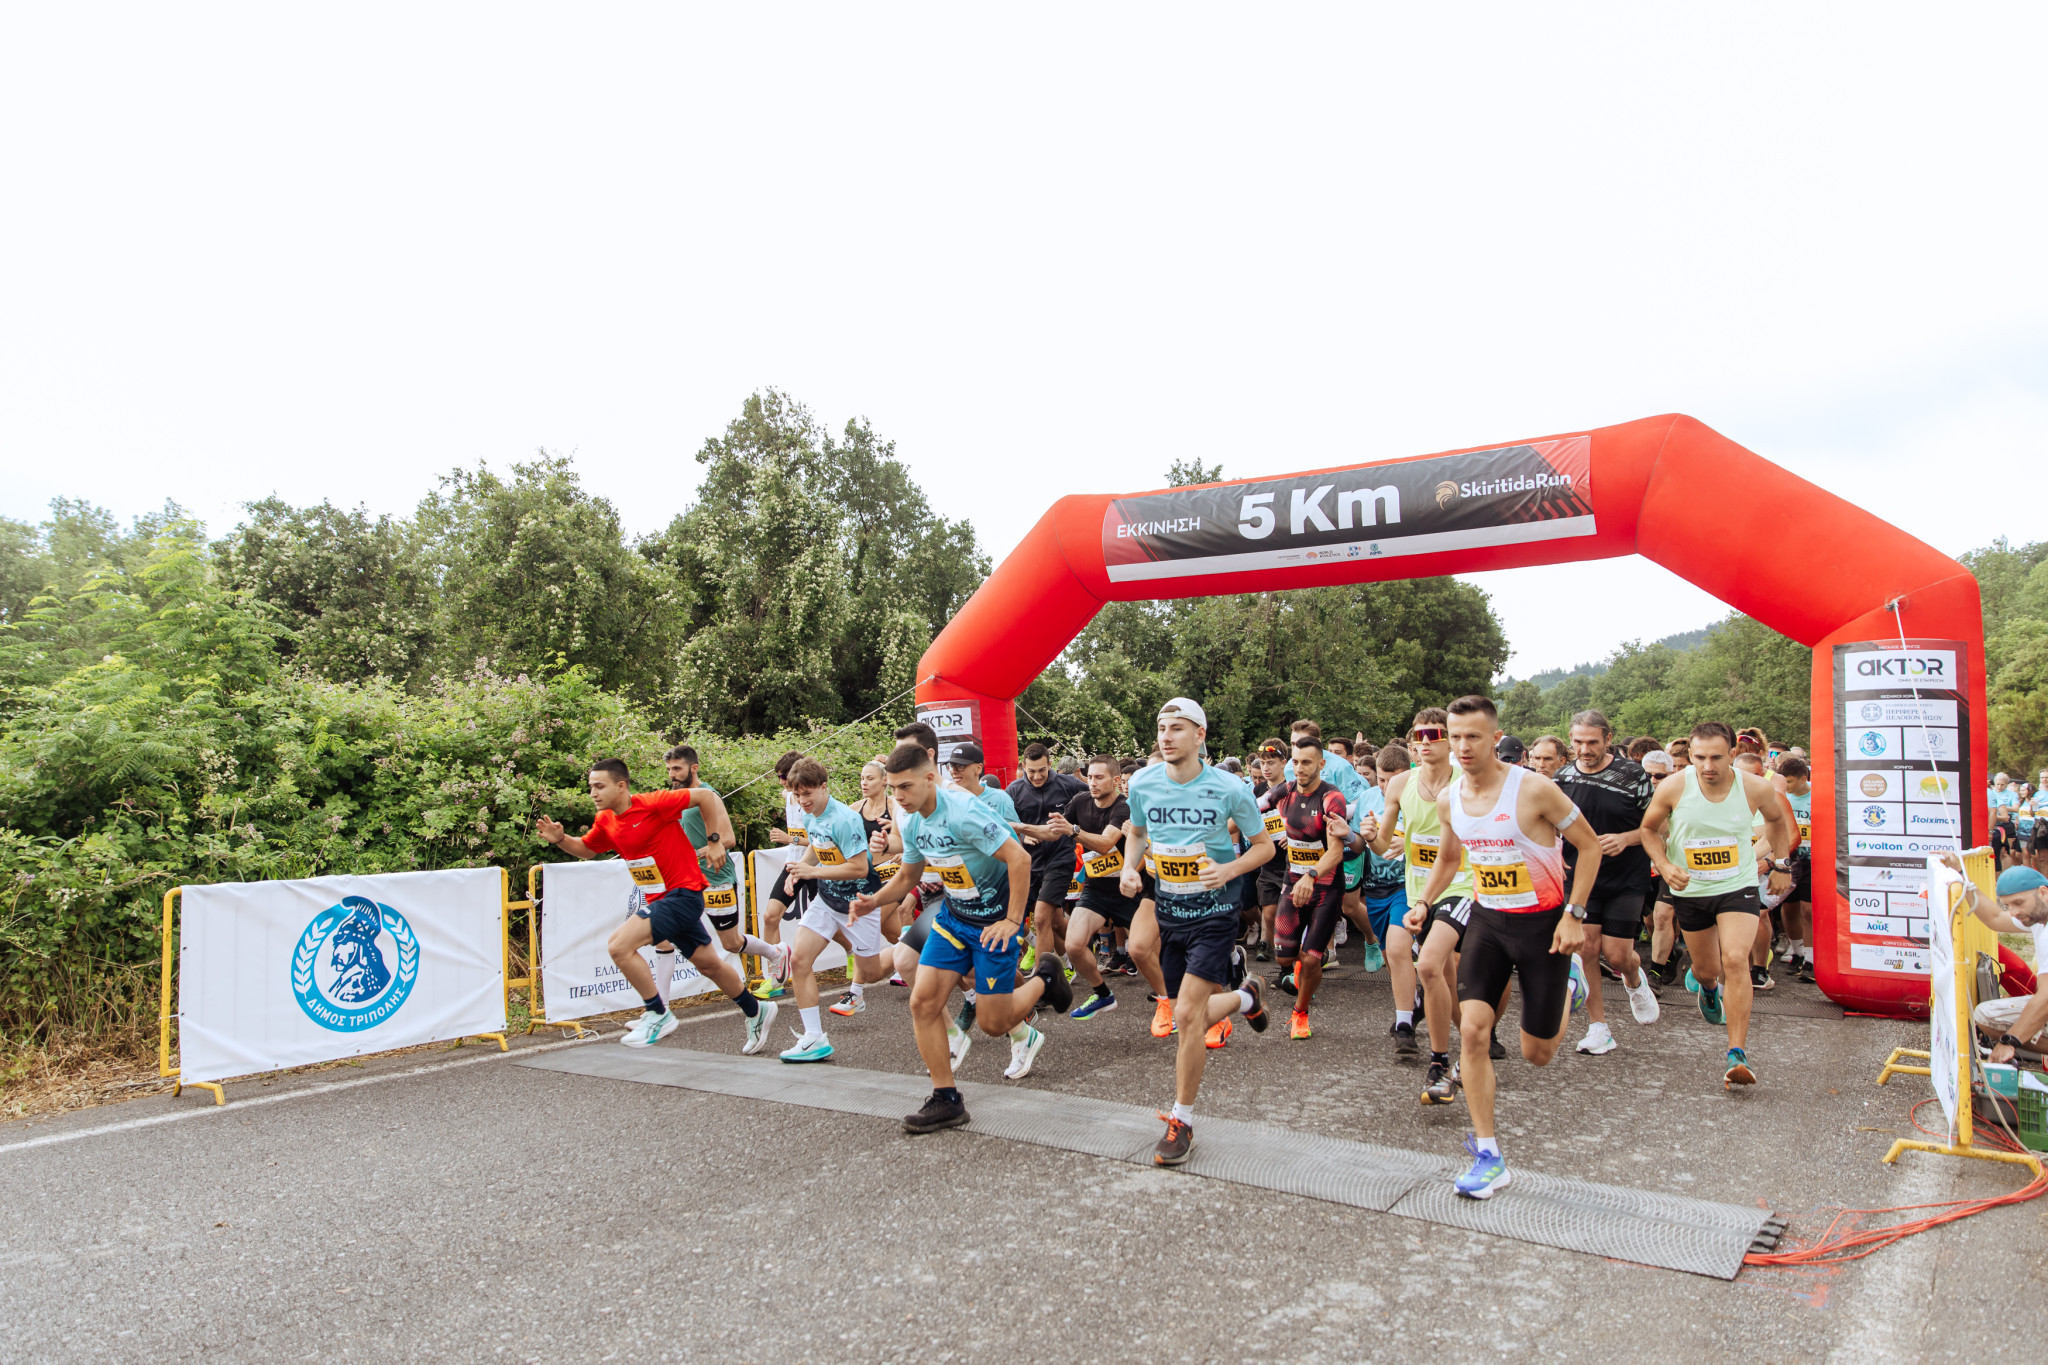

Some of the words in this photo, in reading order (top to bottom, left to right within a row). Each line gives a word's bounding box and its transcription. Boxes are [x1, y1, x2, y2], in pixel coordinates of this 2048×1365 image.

[1460, 473, 1572, 499] SkiritidaRun
[1237, 493, 1277, 540] 5
[1290, 483, 1402, 534] Km
[1117, 516, 1201, 539] ΕΚΚΙΝΗΣΗ
[1265, 818, 1283, 831] 5672
[1869, 842, 1903, 851] volton
[1419, 848, 1437, 863] 55
[1693, 850, 1731, 866] 5309
[1092, 855, 1119, 874] 5543
[1161, 861, 1199, 876] 5673
[633, 870, 656, 881] 5146
[708, 893, 731, 905] 5415
[306, 997, 345, 1027] ΔΗΜΟΣ
[349, 987, 405, 1027] ΤΡΙΠΟΛΗΣ
